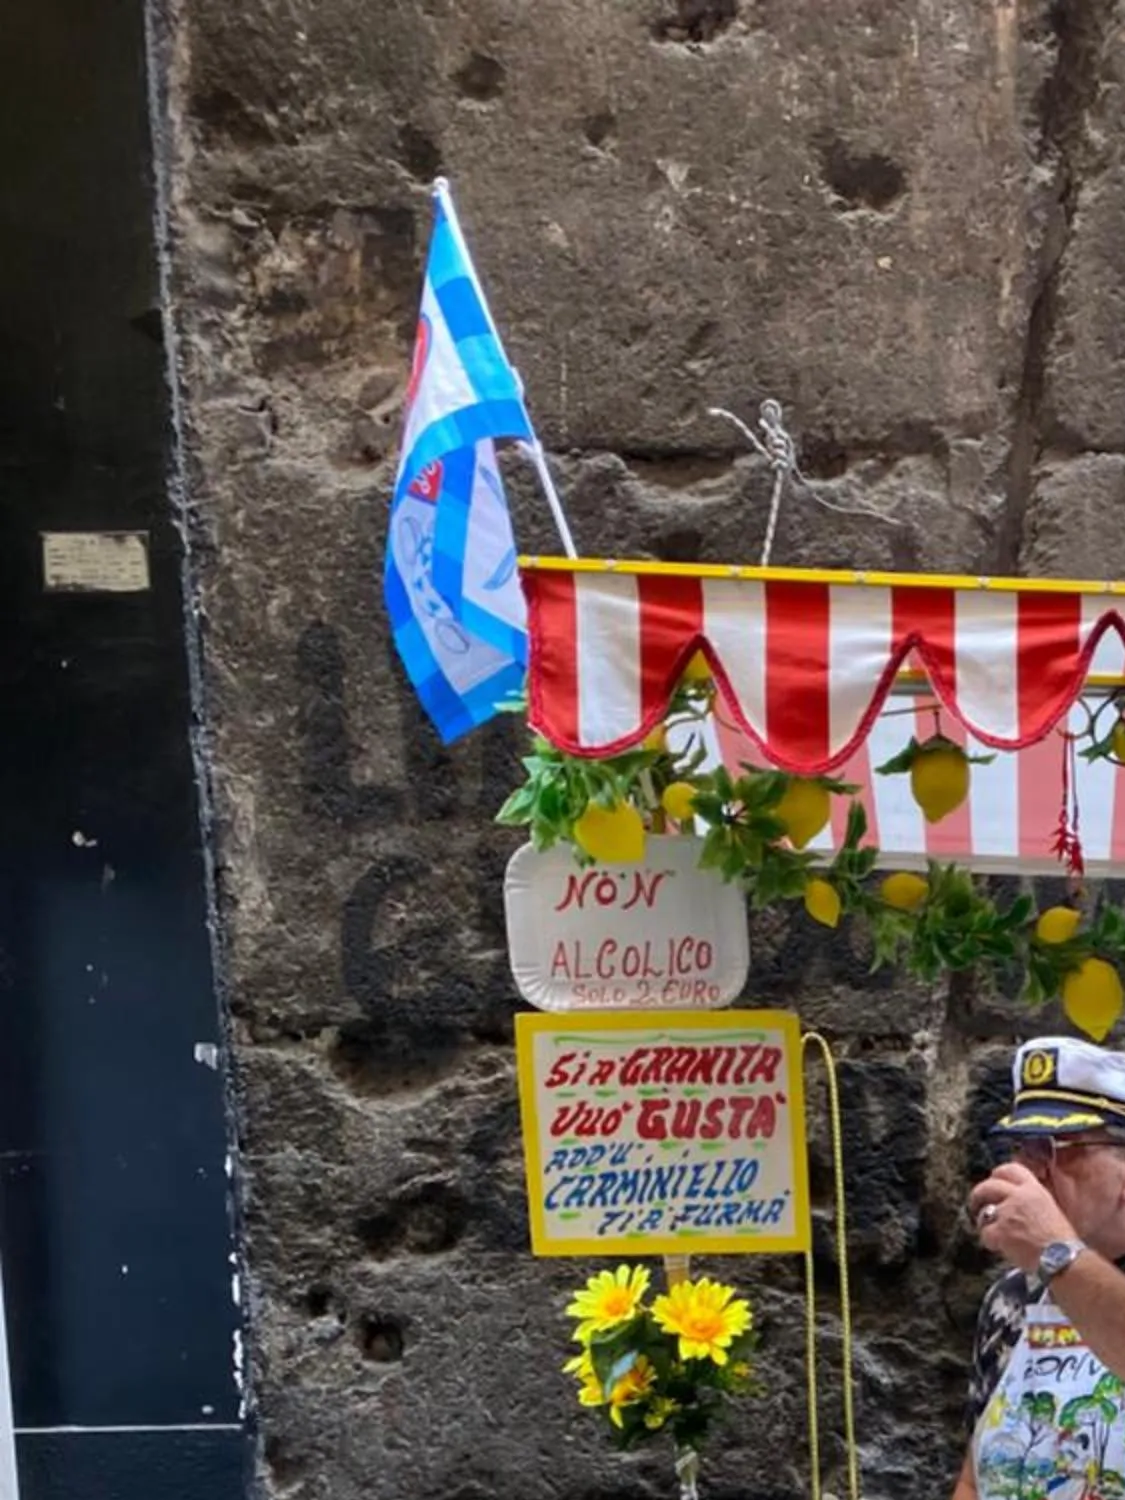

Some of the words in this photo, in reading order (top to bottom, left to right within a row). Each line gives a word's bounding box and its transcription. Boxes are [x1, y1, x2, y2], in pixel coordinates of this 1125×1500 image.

[555, 871, 664, 911] NON
[551, 936, 713, 979] ALCOLICO
[661, 978, 721, 1003] EURO
[619, 1044, 781, 1086] GRANITA
[544, 1150, 759, 1211] CARMINIELLO
